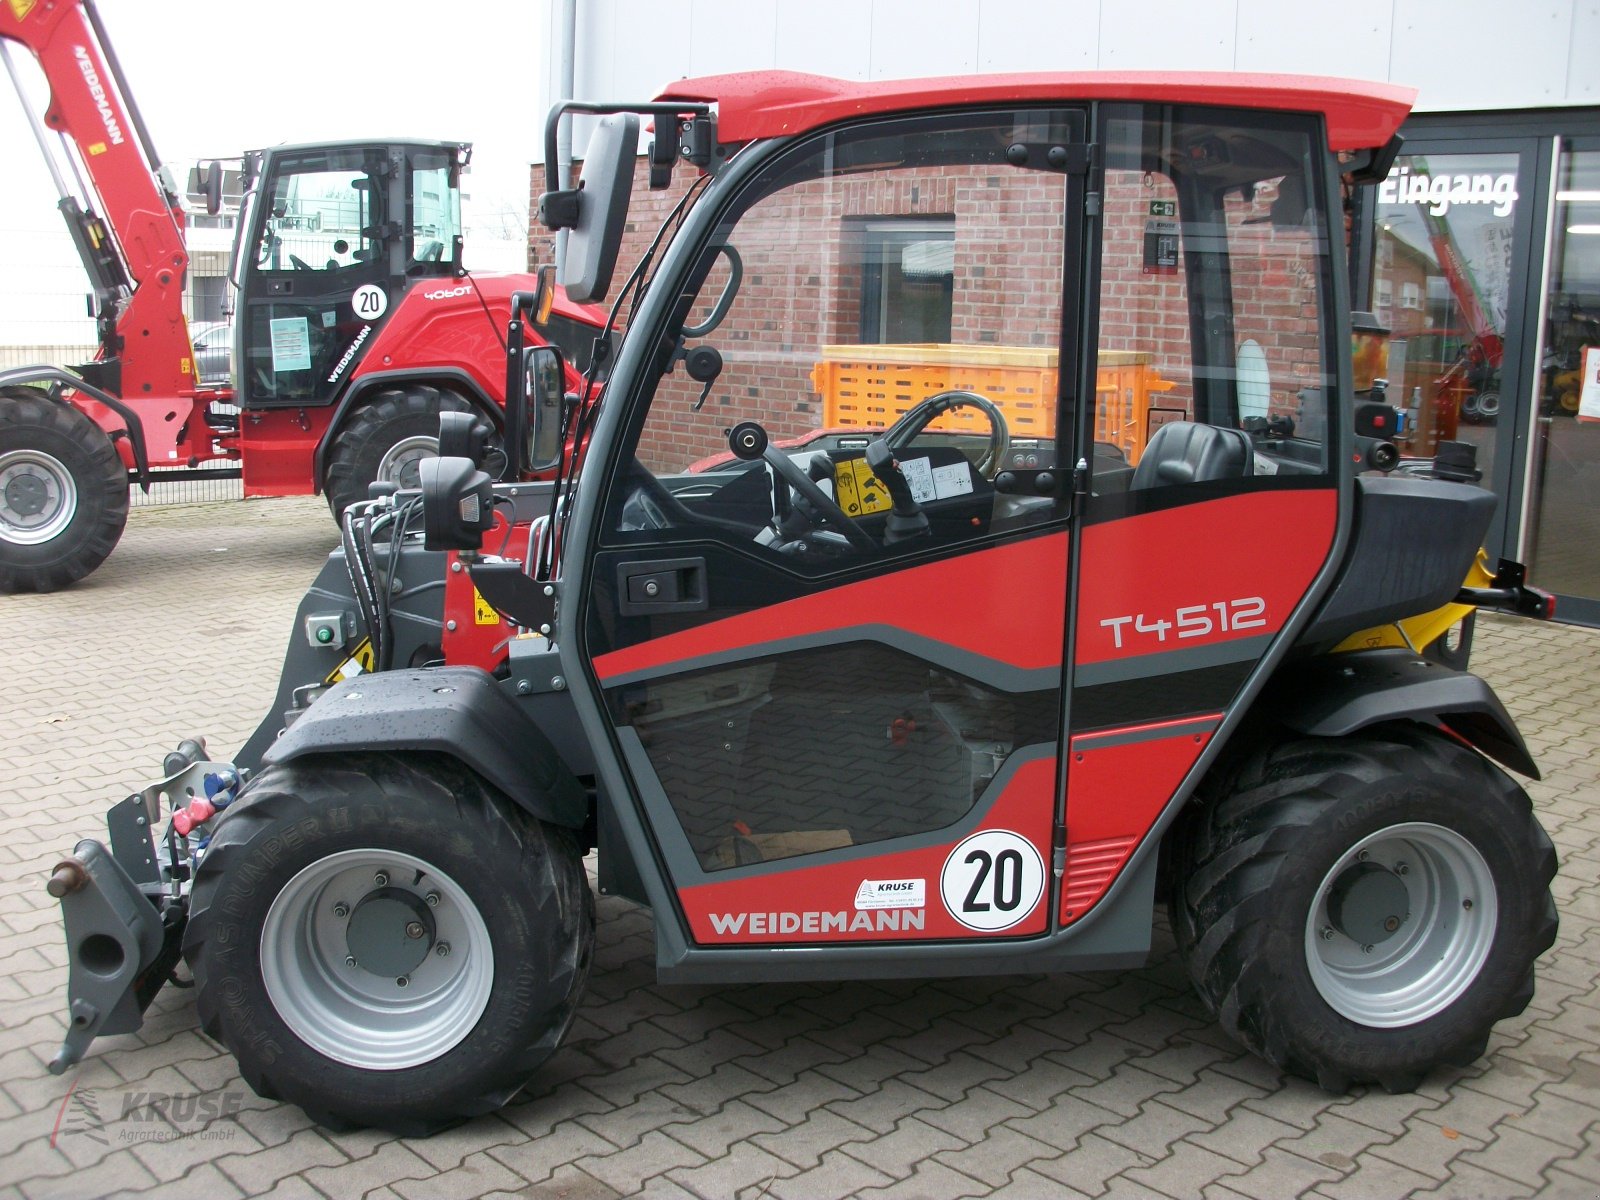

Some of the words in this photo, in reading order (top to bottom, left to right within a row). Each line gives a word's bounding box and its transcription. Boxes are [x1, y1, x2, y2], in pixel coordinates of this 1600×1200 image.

[1378, 166, 1515, 217] Eingang
[360, 291, 380, 313] 20
[424, 285, 473, 300] 4060T
[327, 324, 372, 384] WEIDEMANN
[1100, 596, 1267, 648] T4512
[222, 814, 326, 918] DUMPER
[877, 882, 915, 892] KRUSE
[962, 848, 1023, 913] 20
[708, 908, 926, 935] WEIDEMANN
